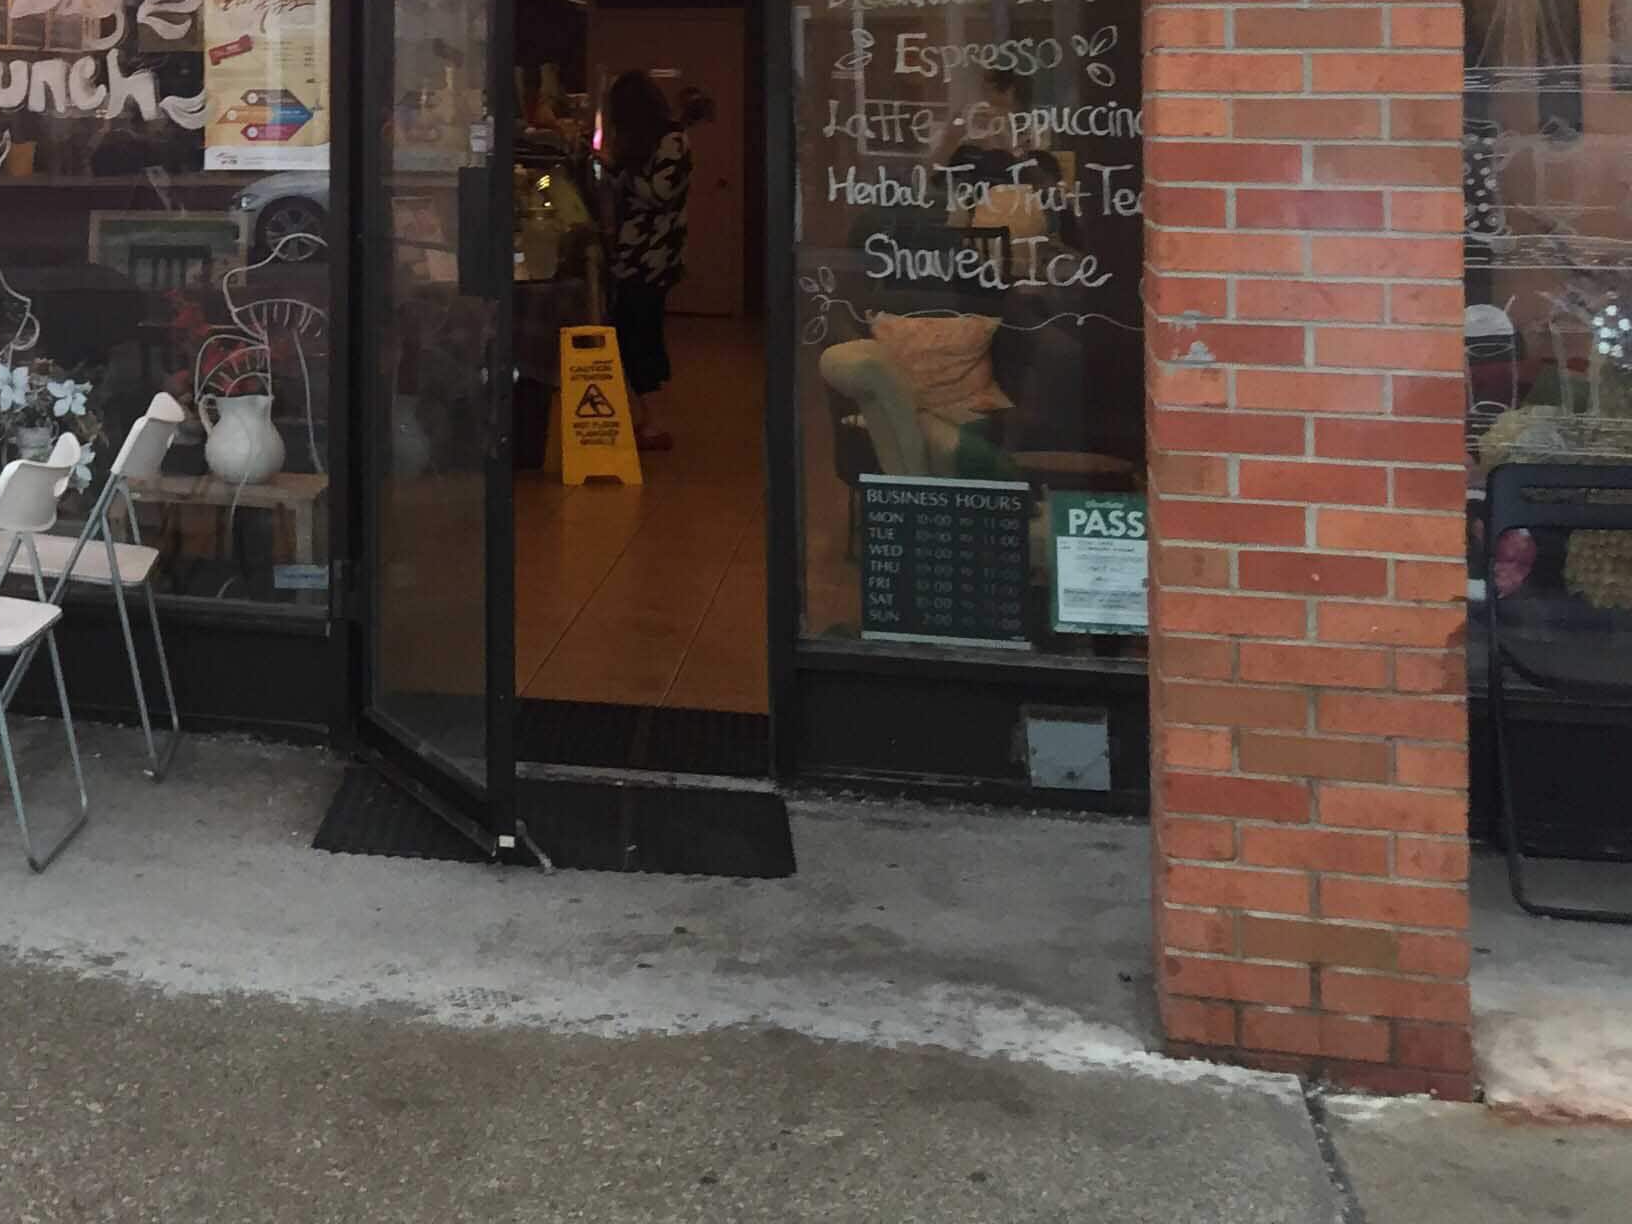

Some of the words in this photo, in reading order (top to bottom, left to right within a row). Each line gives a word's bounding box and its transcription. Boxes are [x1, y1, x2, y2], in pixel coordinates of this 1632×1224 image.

[893, 31, 1064, 84] Espresso
[826, 164, 935, 210] Herbal
[932, 162, 993, 213] Tea
[864, 231, 1010, 290] Shaved
[1013, 234, 1113, 288] Ice
[866, 488, 949, 507] BUSINESS
[955, 492, 1023, 511] HOURS
[1068, 508, 1146, 538] PASS
[868, 544, 904, 558] WED
[868, 576, 891, 590] FRI
[868, 593, 895, 607] SAT
